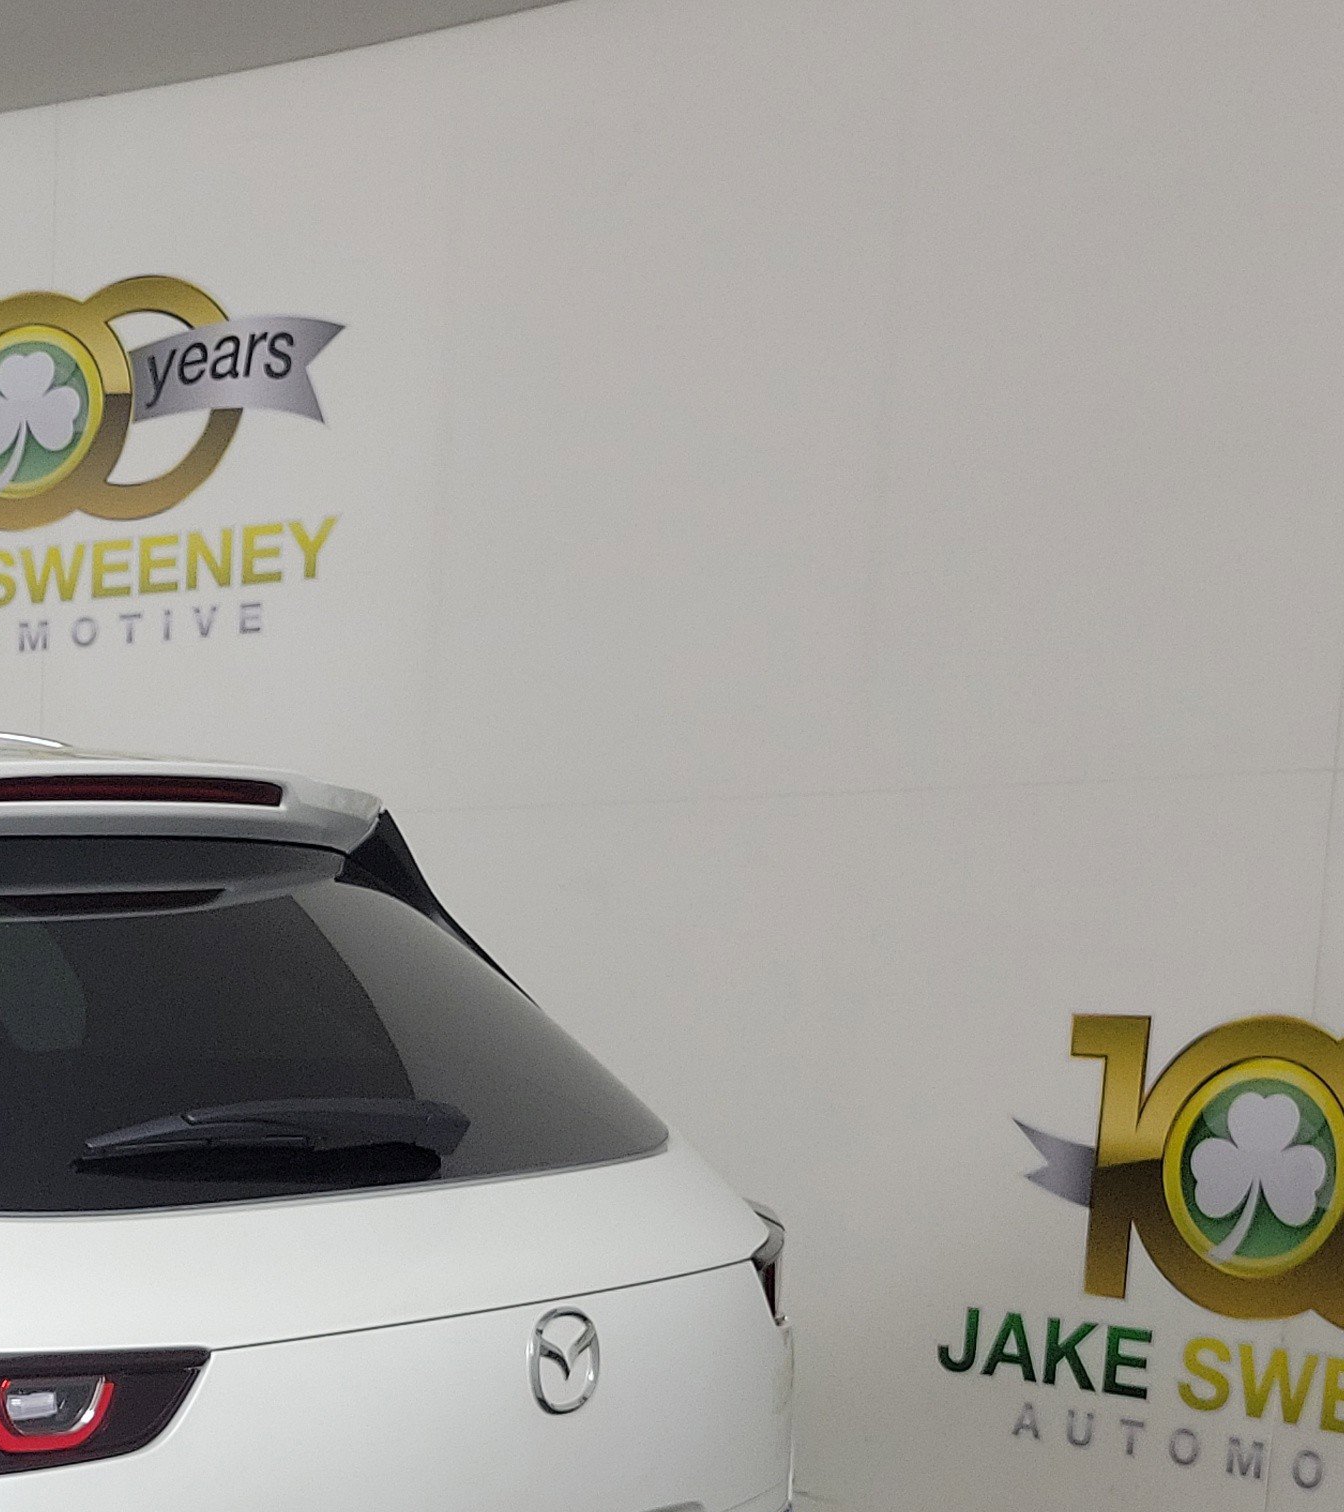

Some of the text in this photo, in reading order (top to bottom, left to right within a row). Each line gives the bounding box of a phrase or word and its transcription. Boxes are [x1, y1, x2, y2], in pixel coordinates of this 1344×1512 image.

[145, 330, 295, 408] years
[1069, 1013, 1344, 1332] 10
[936, 1306, 1153, 1400] JAKE
